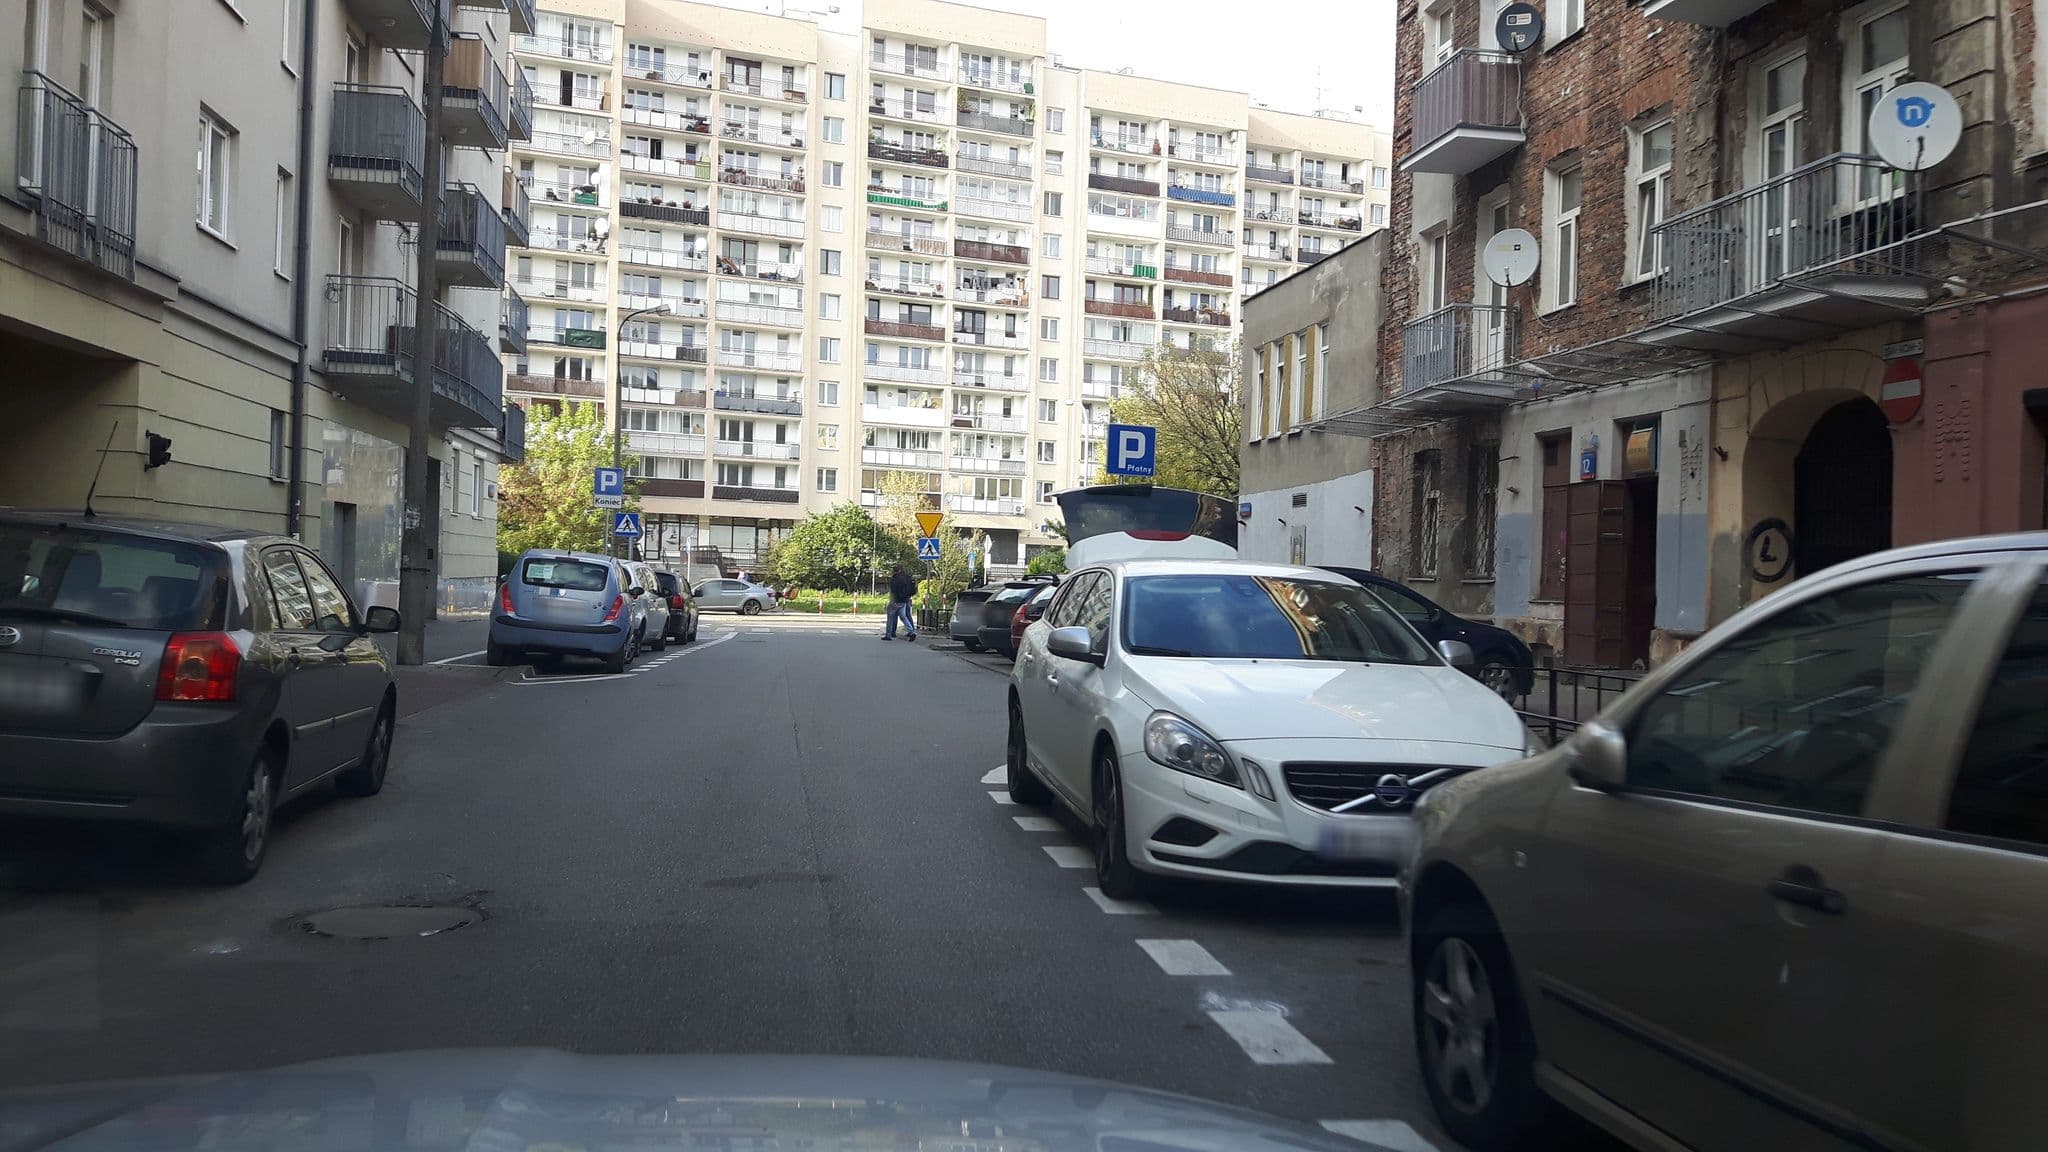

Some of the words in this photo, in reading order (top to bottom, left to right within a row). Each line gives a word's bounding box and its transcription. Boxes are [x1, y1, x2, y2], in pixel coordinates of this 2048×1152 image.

[1118, 430, 1146, 469] P
[1582, 458, 1591, 473] 12
[600, 470, 618, 492] P
[595, 498, 621, 506] Koniec
[92, 647, 142, 658] COROLLA
